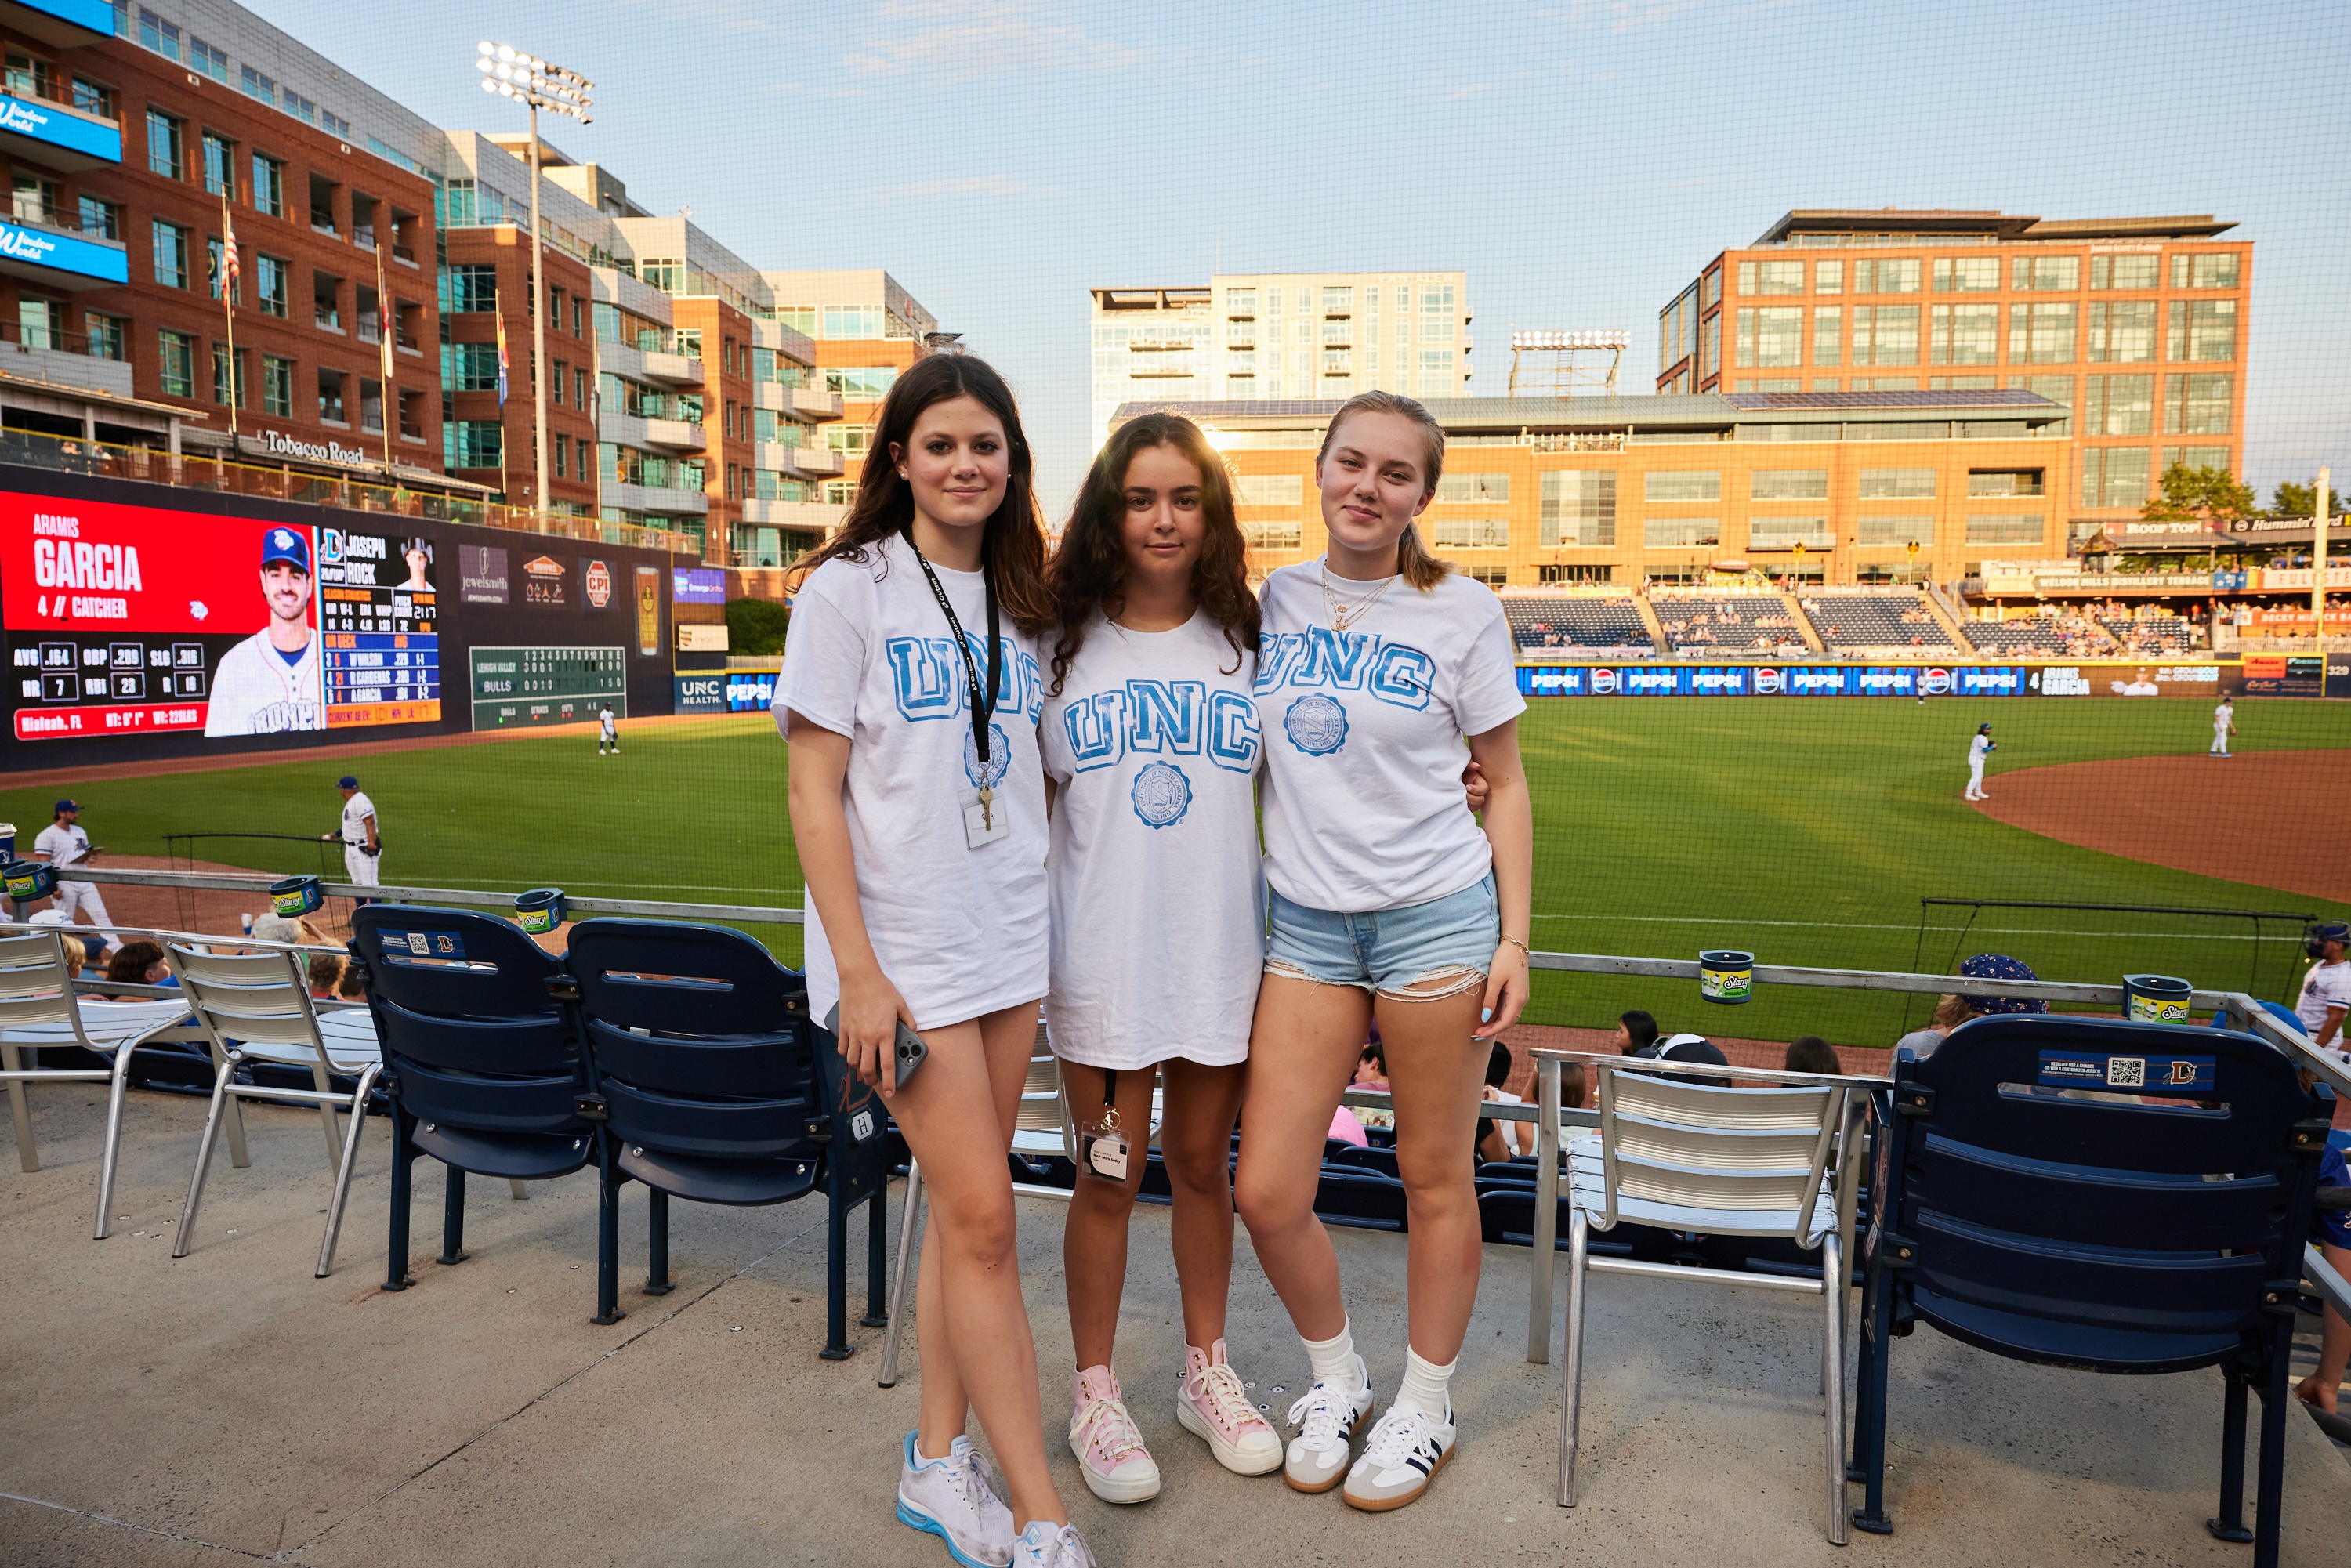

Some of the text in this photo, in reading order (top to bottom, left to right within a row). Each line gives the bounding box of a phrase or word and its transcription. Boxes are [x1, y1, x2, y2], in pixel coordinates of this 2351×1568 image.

[266, 430, 364, 465] Tobacco Road
[34, 513, 79, 538] ARAMIS
[2126, 522, 2199, 534] ROOF TOP
[346, 535, 386, 559] JOSEPH
[34, 538, 143, 592] GARCIA
[347, 562, 376, 585] ROCK
[2040, 577, 2078, 587] WELDON
[2081, 577, 2109, 587] MILLS
[2110, 576, 2164, 587] DISTILLERY
[2167, 575, 2210, 585] TERRACE
[462, 575, 508, 591] jewelsmith
[589, 577, 608, 591] CPI
[931, 577, 944, 601] Outset
[38, 595, 128, 619] 4 CATCHER
[359, 603, 372, 616] ERA
[414, 606, 436, 620] 2117
[950, 617, 962, 641] Outset
[337, 634, 357, 649] DECK
[13, 648, 38, 666] AVG
[44, 649, 70, 666] .164
[82, 648, 107, 666] OBP
[113, 648, 139, 665] .209
[150, 650, 171, 666] SLG
[177, 649, 199, 665] .316
[325, 652, 332, 667] 3
[357, 652, 383, 667] WILSON
[524, 650, 529, 661] 1
[532, 650, 537, 661] 2
[540, 650, 545, 661] 3
[547, 650, 552, 660] 4
[556, 650, 560, 661] 5
[563, 650, 567, 661] 6
[570, 650, 574, 661] 7
[477, 662, 497, 673] LEHIGH
[498, 662, 516, 673] VALLEY
[524, 662, 530, 673] 3
[532, 662, 537, 673] 0
[540, 662, 545, 673] 0
[549, 662, 552, 672] 1
[616, 662, 621, 671] 0
[966, 657, 975, 683] Outset
[1254, 624, 1436, 712] UNC
[2042, 667, 2079, 680] ARAMIS
[2327, 665, 2349, 675] 329
[121, 677, 136, 694] 23
[162, 676, 172, 693] R
[185, 675, 197, 693] 19
[327, 671, 333, 686] 4
[356, 670, 391, 685] CARDENAS
[484, 680, 512, 693] BULLS
[524, 680, 530, 691] 0
[533, 680, 538, 690] 0
[541, 680, 545, 690] 1
[548, 679, 552, 690] 0
[600, 678, 603, 687] 1
[616, 678, 621, 687] 0
[886, 631, 1045, 726] UNC
[1531, 675, 1579, 688] PEPSI
[1629, 675, 1677, 688] PEPSI
[1692, 675, 1741, 688] PEPSI
[1794, 675, 1844, 688] PEPSI
[1860, 675, 1911, 688] PEPSI
[1965, 675, 2017, 688] PEPSI
[2029, 672, 2039, 690] 4
[22, 679, 41, 697] HR
[56, 679, 64, 697] 7
[85, 678, 107, 695] RBI
[681, 680, 719, 696] UNC
[726, 683, 773, 701] PEPSI
[2041, 679, 2090, 696] GARCIA
[336, 690, 342, 703] 4
[357, 687, 382, 703] GARCIA
[70, 714, 83, 730] FL
[328, 711, 353, 723] CURRENT
[1291, 705, 1306, 735] UNIVERSITY
[1315, 701, 1334, 712] NORTH
[1063, 679, 1261, 774] UNC
[1299, 737, 1320, 747] CHAPEL
[1157, 770, 1176, 781] NORTH
[1174, 780, 1183, 808] CAROLINA
[1160, 810, 1174, 819] HILL
[11, 880, 31, 890] Starry
[280, 896, 300, 907] Starry
[525, 915, 546, 925] Starry
[1723, 975, 1750, 990] Starry
[2161, 1005, 2188, 1022] Starry
[857, 1116, 869, 1135] H
